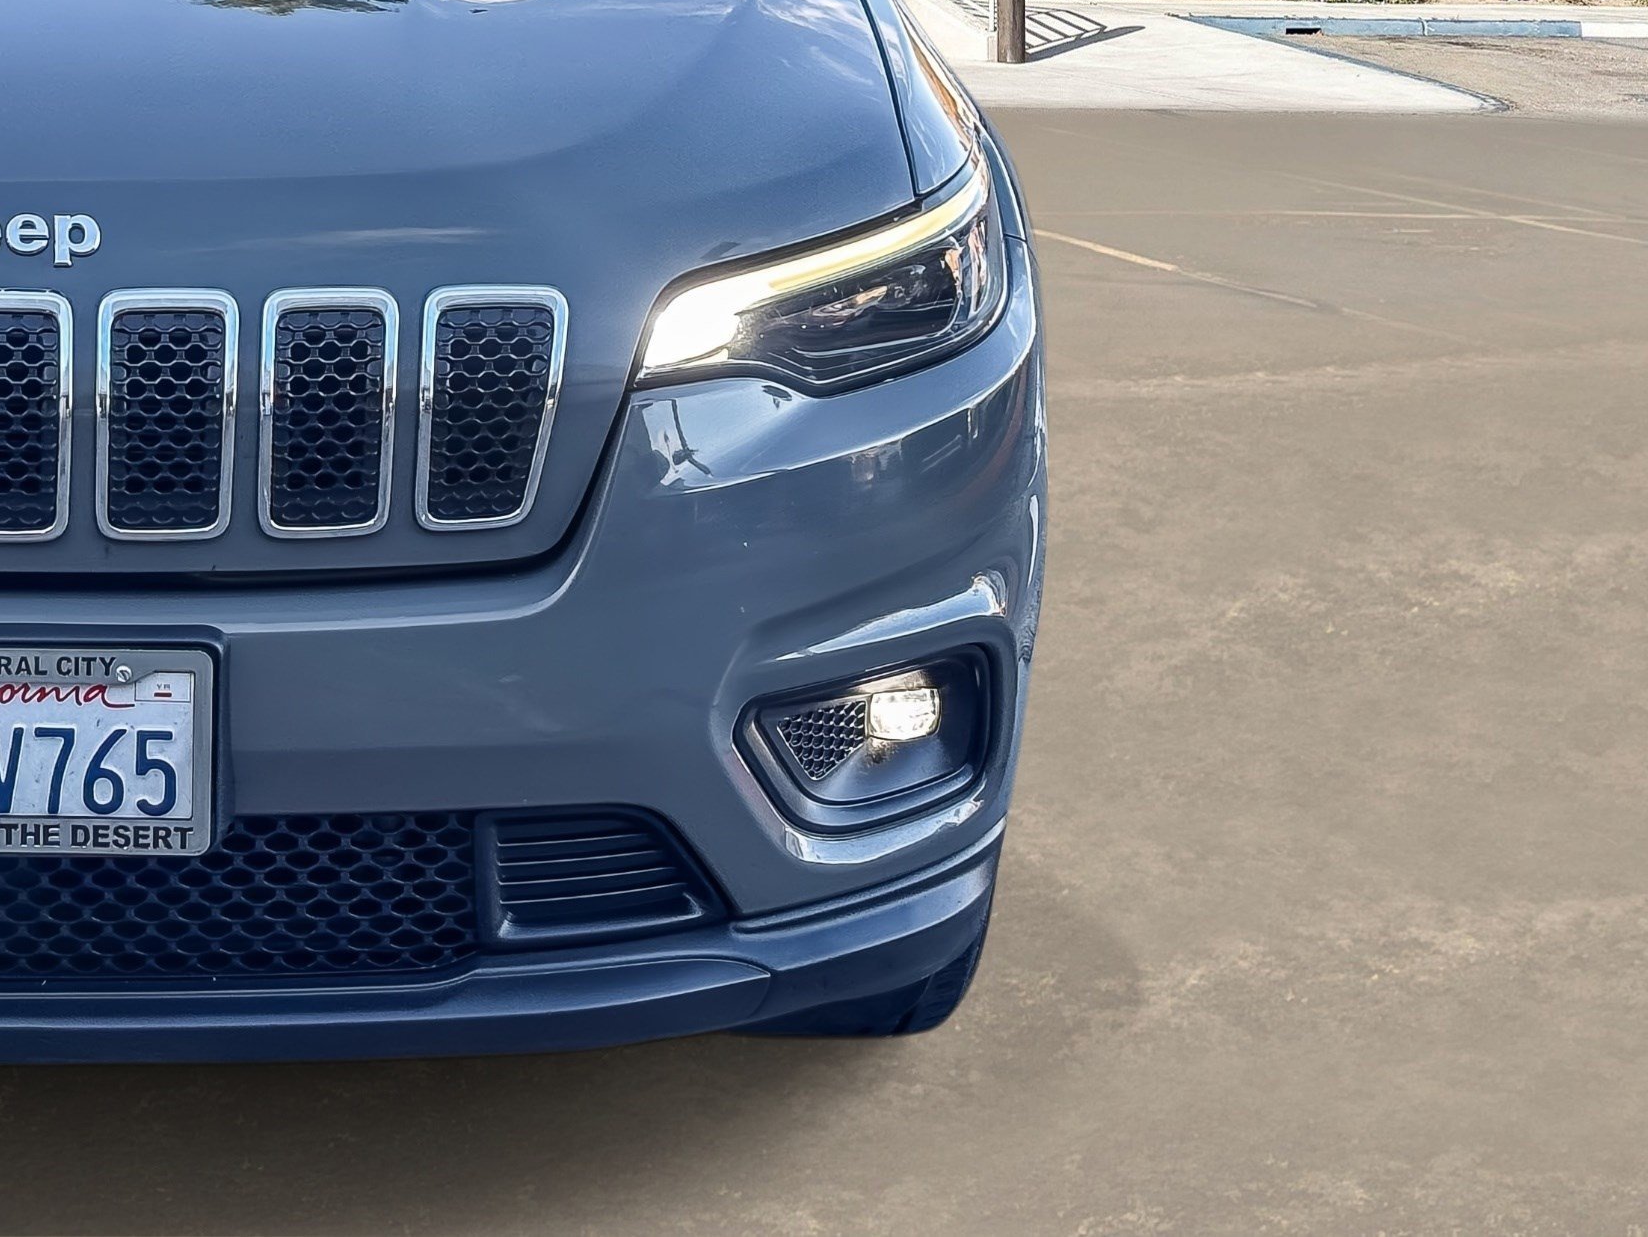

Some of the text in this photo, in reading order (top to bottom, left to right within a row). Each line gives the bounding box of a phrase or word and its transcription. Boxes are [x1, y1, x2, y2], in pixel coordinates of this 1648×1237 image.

[56, 655, 117, 678] CITY
[0, 823, 61, 848] THE
[71, 823, 194, 850] DESERT
